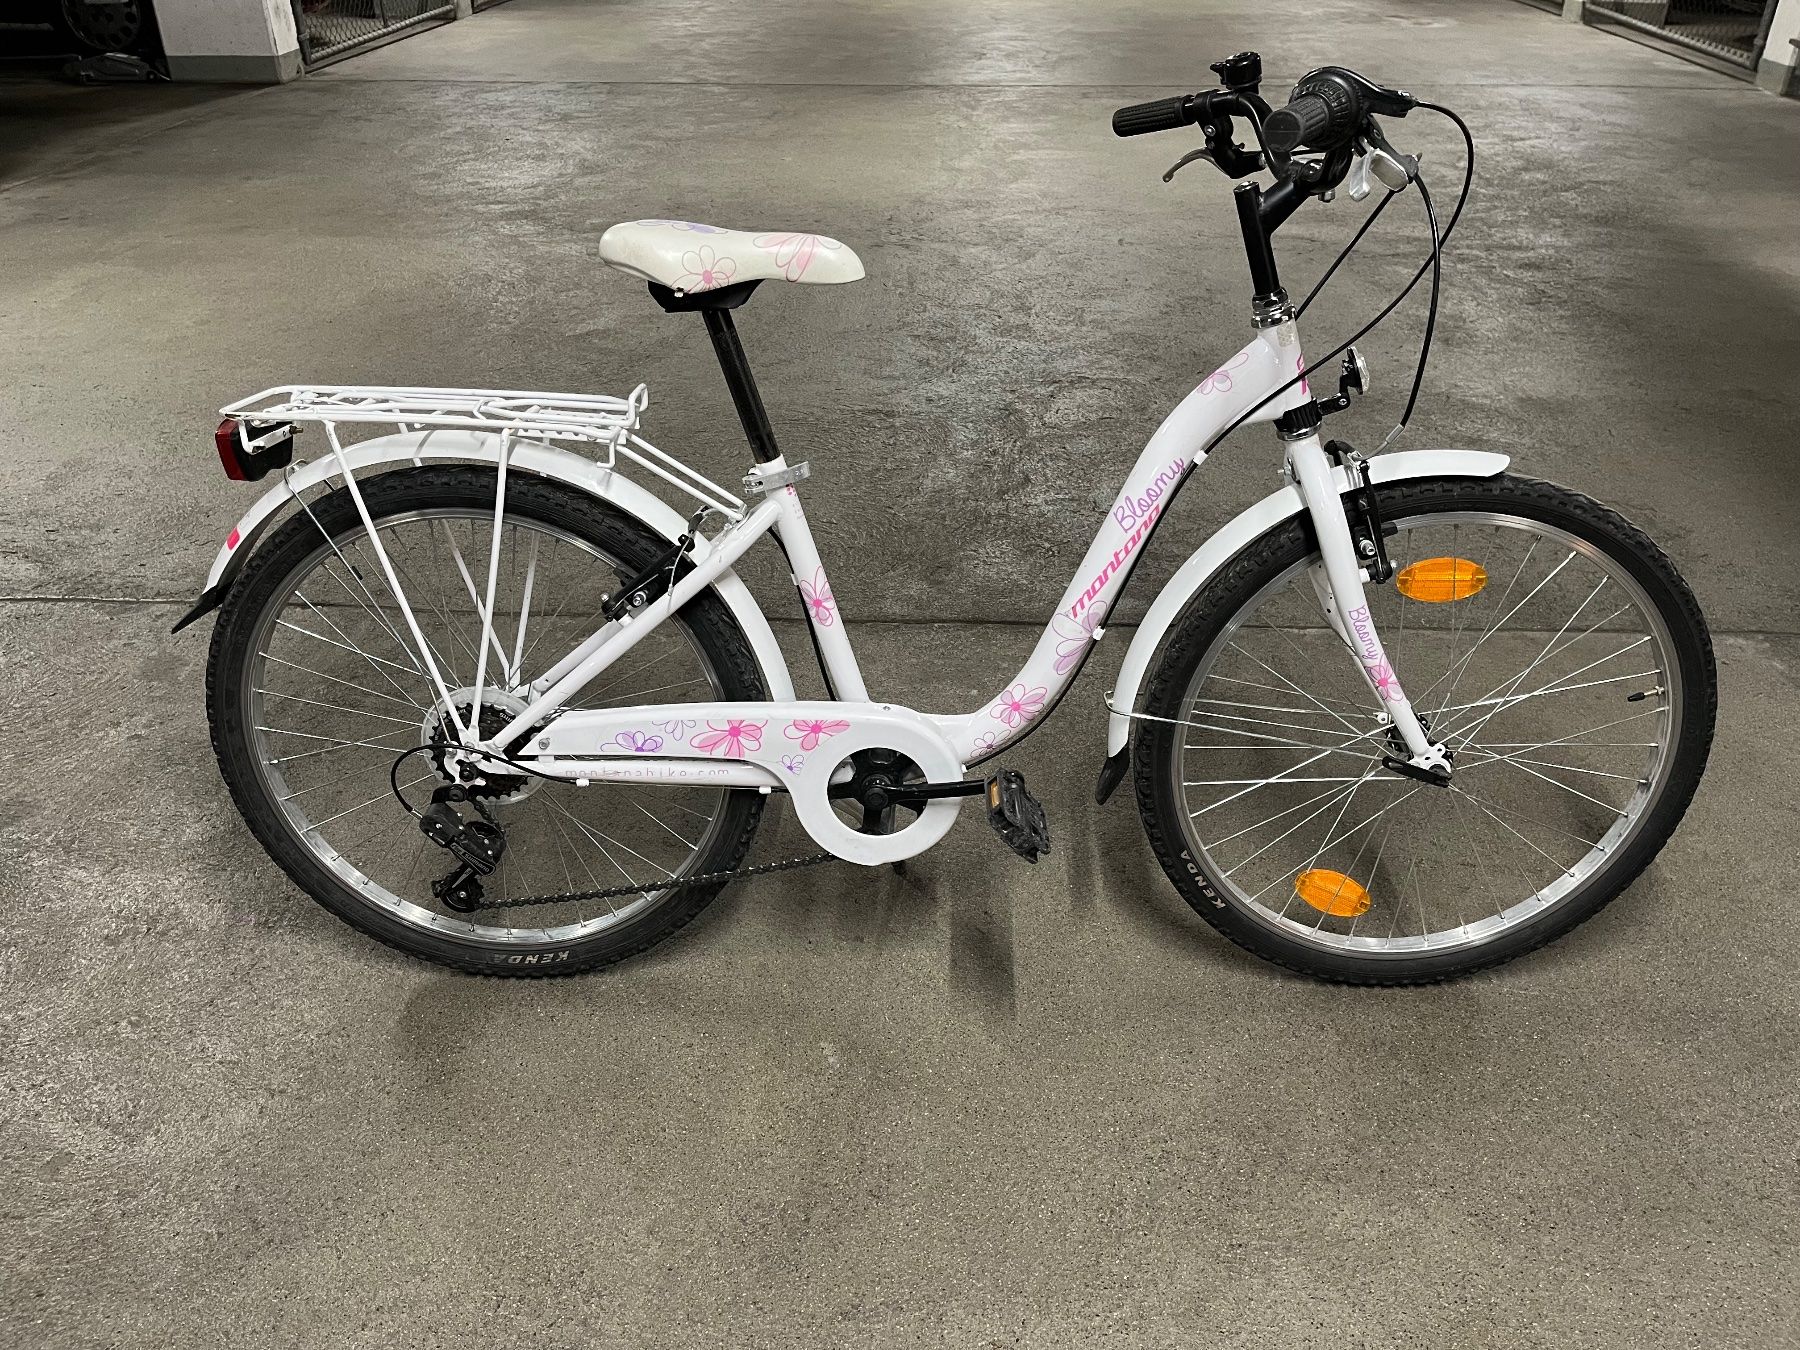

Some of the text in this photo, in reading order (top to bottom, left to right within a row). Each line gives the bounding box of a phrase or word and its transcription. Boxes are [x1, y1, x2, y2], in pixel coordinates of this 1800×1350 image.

[1113, 457, 1186, 534] Bloomy
[1071, 503, 1161, 619] montana
[1348, 605, 1378, 660] Bloomy
[1181, 849, 1226, 909] KENDA
[493, 950, 570, 964] KENDA
